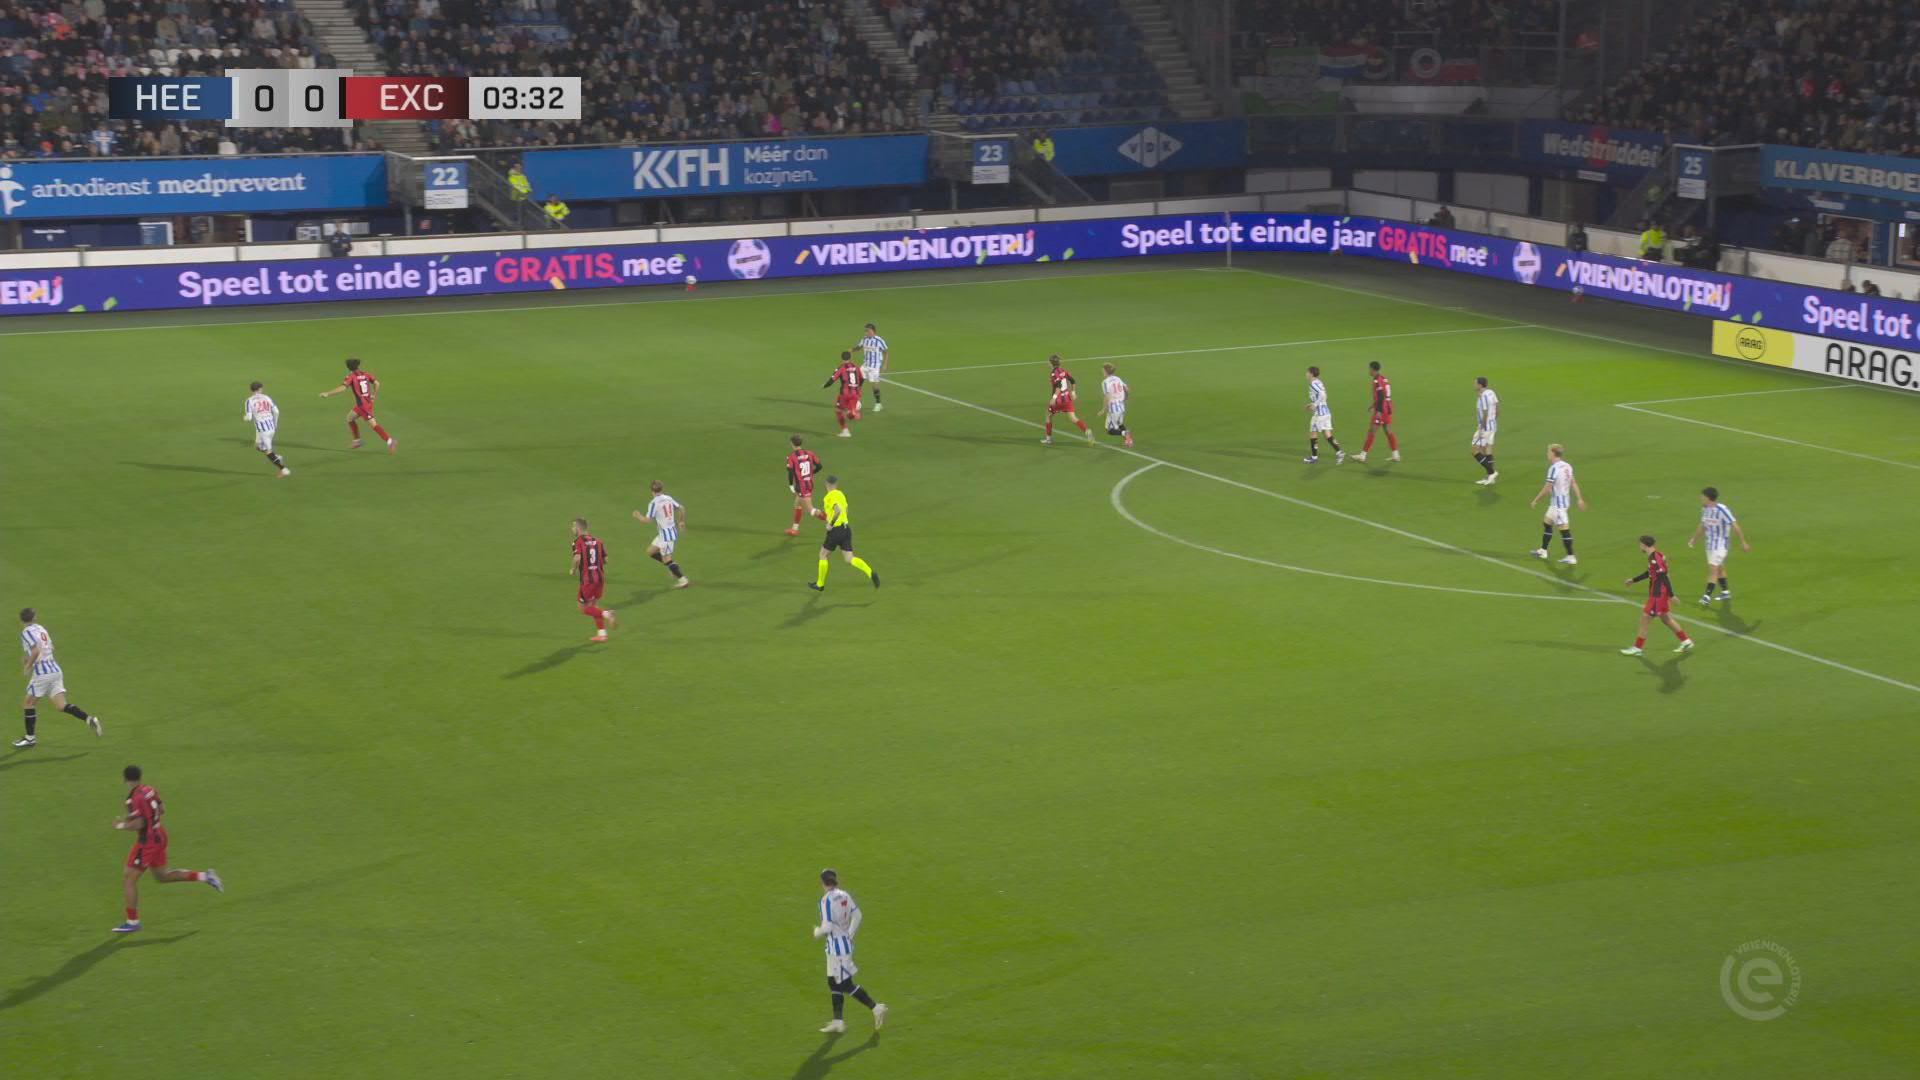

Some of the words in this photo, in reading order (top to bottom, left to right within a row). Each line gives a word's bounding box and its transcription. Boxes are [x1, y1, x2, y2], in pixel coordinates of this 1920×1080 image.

[744, 144, 791, 164] Méér
[793, 145, 828, 161] dan
[980, 144, 1003, 162] 23
[432, 167, 459, 186] 22
[632, 147, 730, 190] KKFH
[1684, 155, 1703, 176] 25
[32, 177, 151, 198] arbodienst
[158, 172, 306, 198] medprevent
[744, 167, 818, 188] kozijnen.
[810, 229, 1035, 266] VRIENDENLOTERIJ
[1121, 219, 1194, 254] Speel
[1200, 222, 1244, 244] tot
[1250, 218, 1328, 244] einde
[1332, 220, 1376, 250] jaar
[1379, 226, 1448, 260] GRATIS
[1450, 244, 1488, 267] mee
[178, 267, 271, 305] Speel
[277, 269, 329, 294] tot
[335, 262, 421, 291] einde
[426, 260, 487, 296] jaar
[495, 252, 616, 284] GRATIS
[622, 256, 684, 277] mee
[1567, 259, 1731, 312] VRIENDENLOTERIJ
[1802, 294, 1869, 334] Speel
[1873, 309, 1913, 340] tot
[1740, 337, 1762, 350] ARAG
[799, 461, 810, 477] 20
